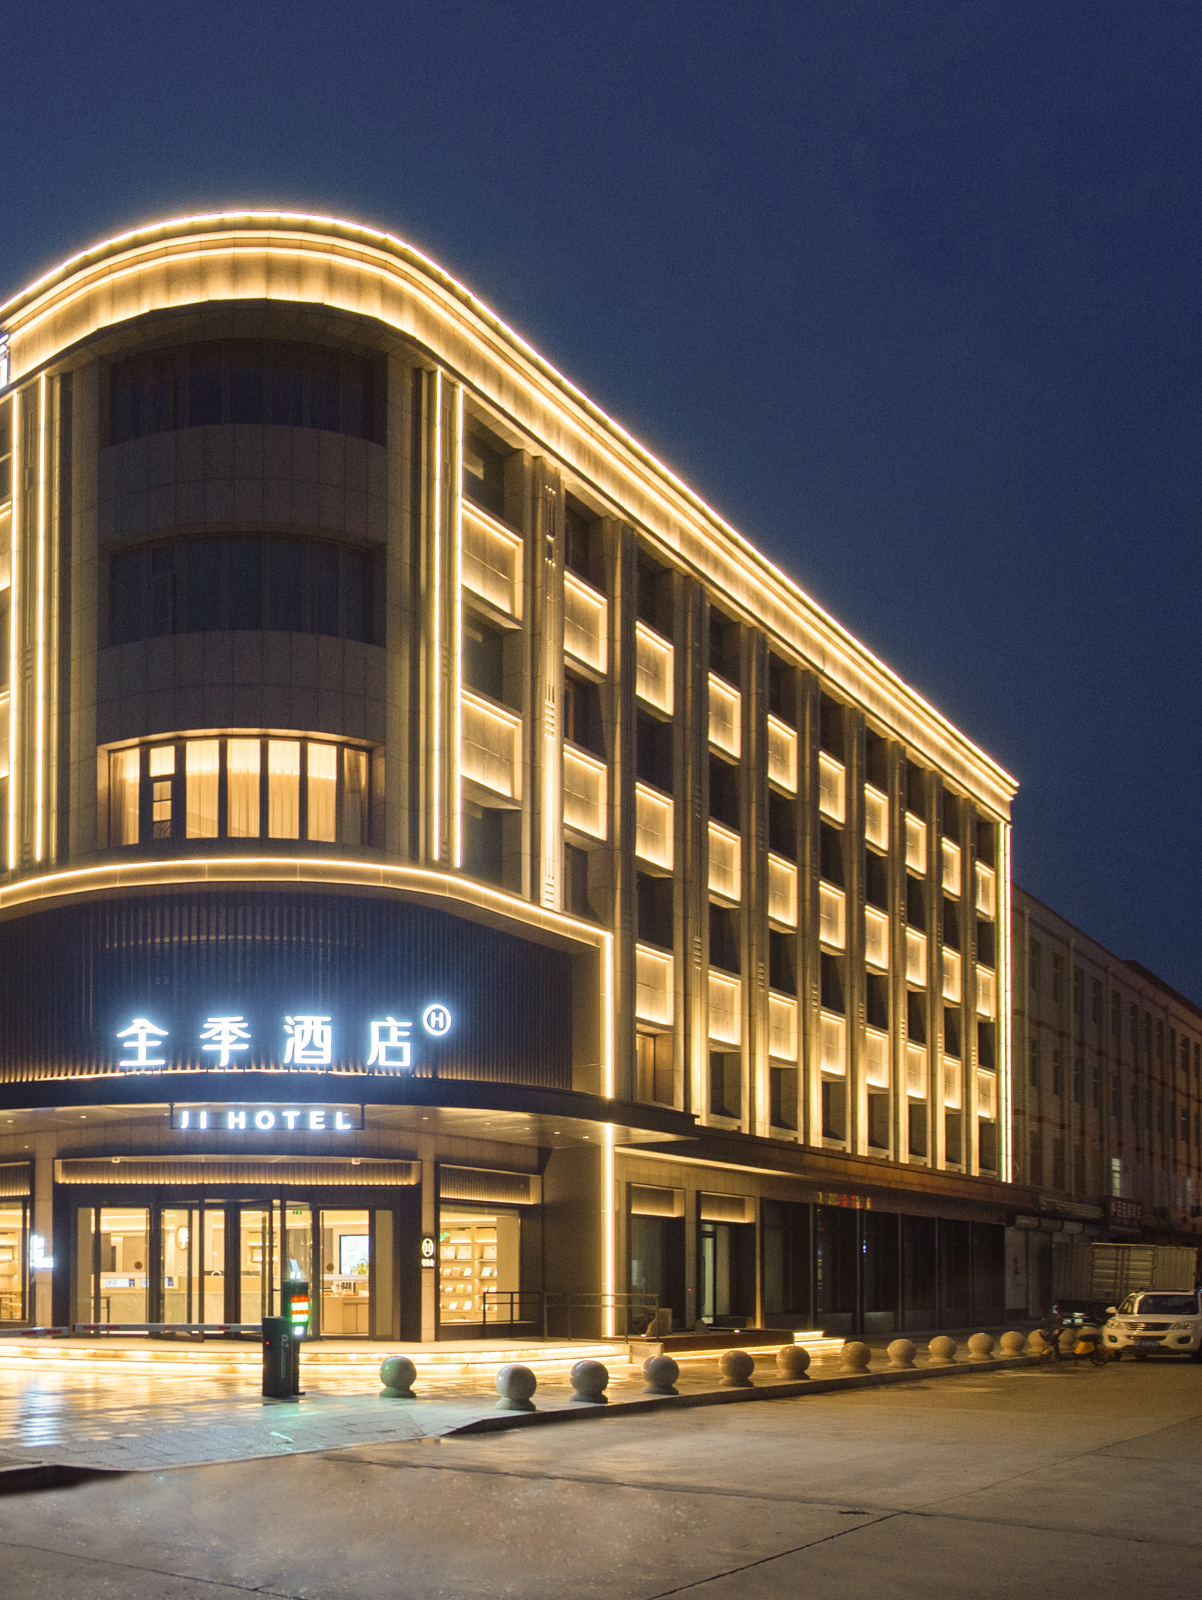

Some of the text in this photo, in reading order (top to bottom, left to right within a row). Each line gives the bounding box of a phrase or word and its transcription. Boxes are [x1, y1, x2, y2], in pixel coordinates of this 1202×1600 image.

[116, 1015, 413, 1068] 全季酒店
[180, 1110, 352, 1130] JI HOTEL
